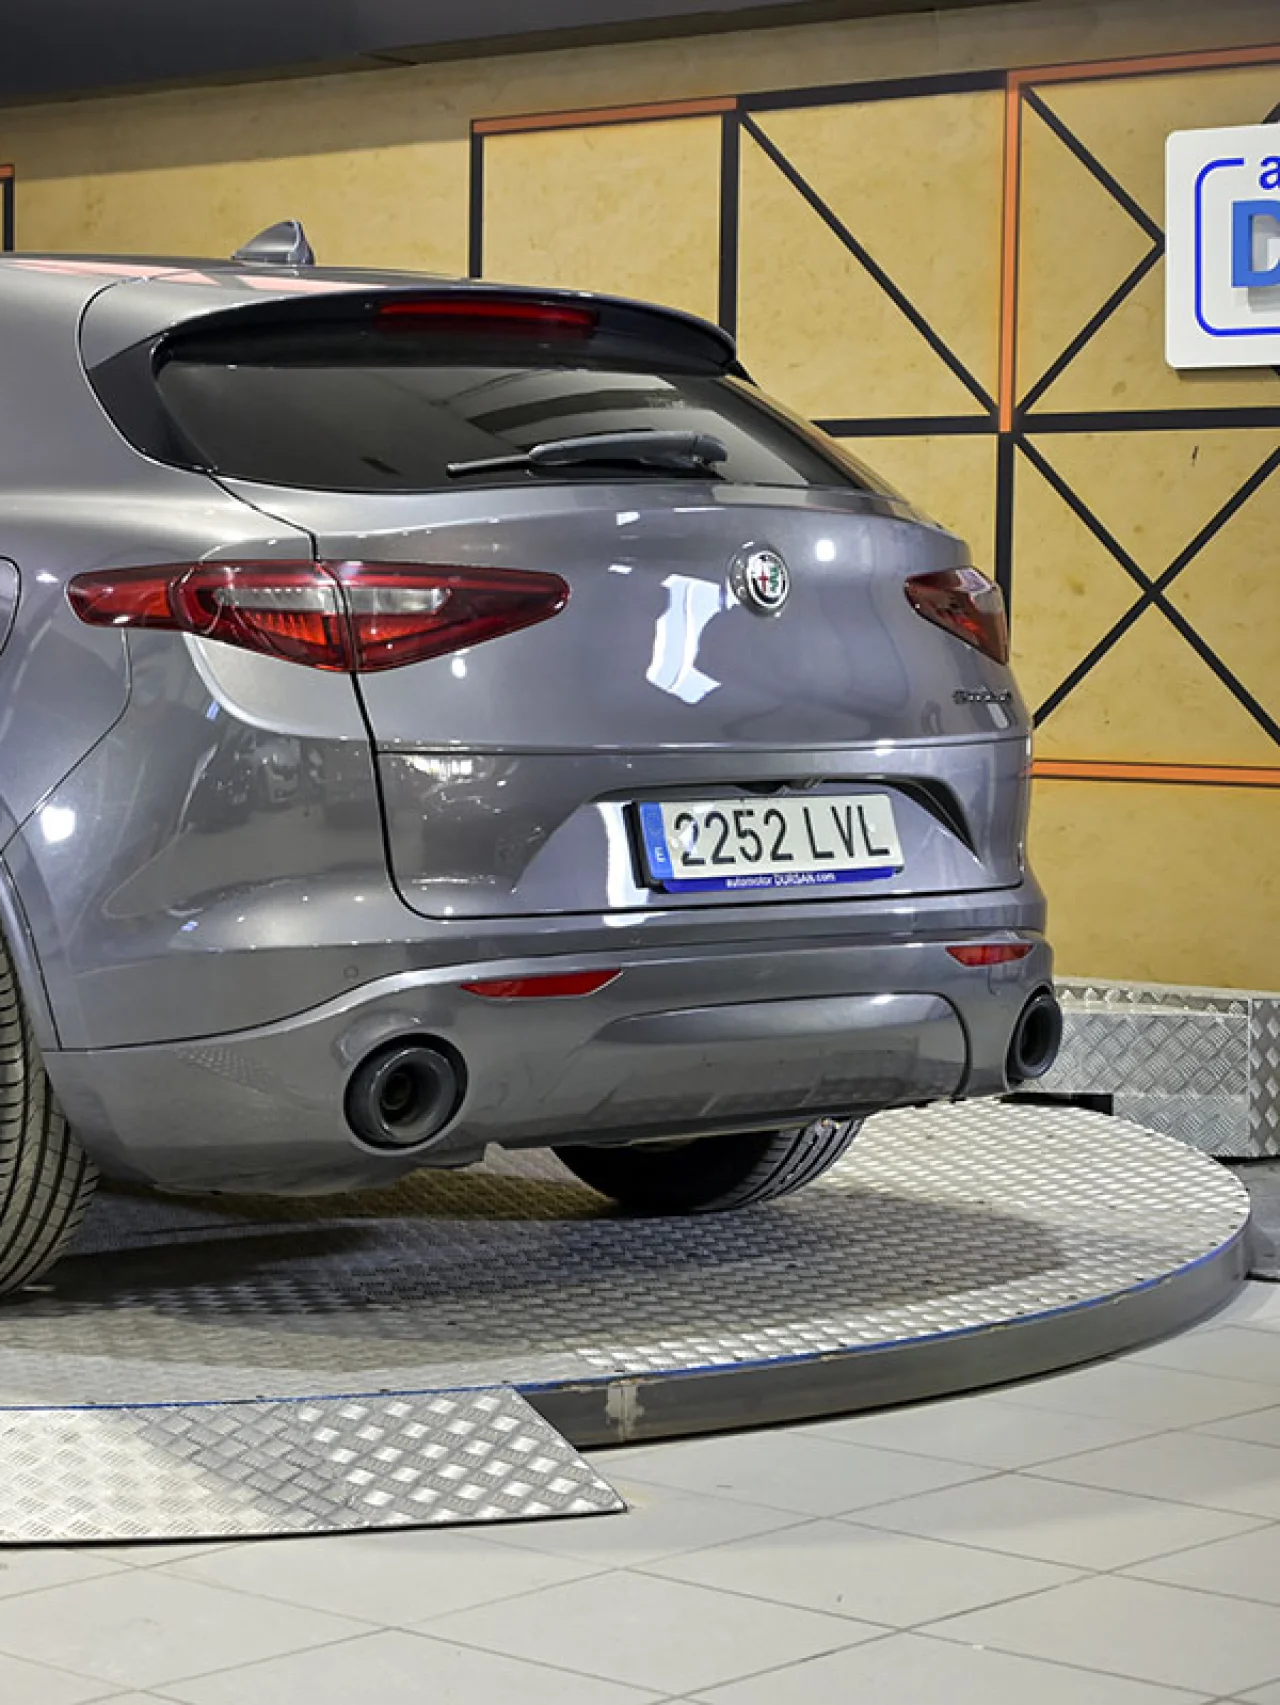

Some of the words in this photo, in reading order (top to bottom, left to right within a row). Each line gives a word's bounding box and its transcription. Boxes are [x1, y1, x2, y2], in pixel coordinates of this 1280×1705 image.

[654, 846, 666, 863] E
[674, 807, 794, 866] 2252
[802, 805, 890, 858] LVL
